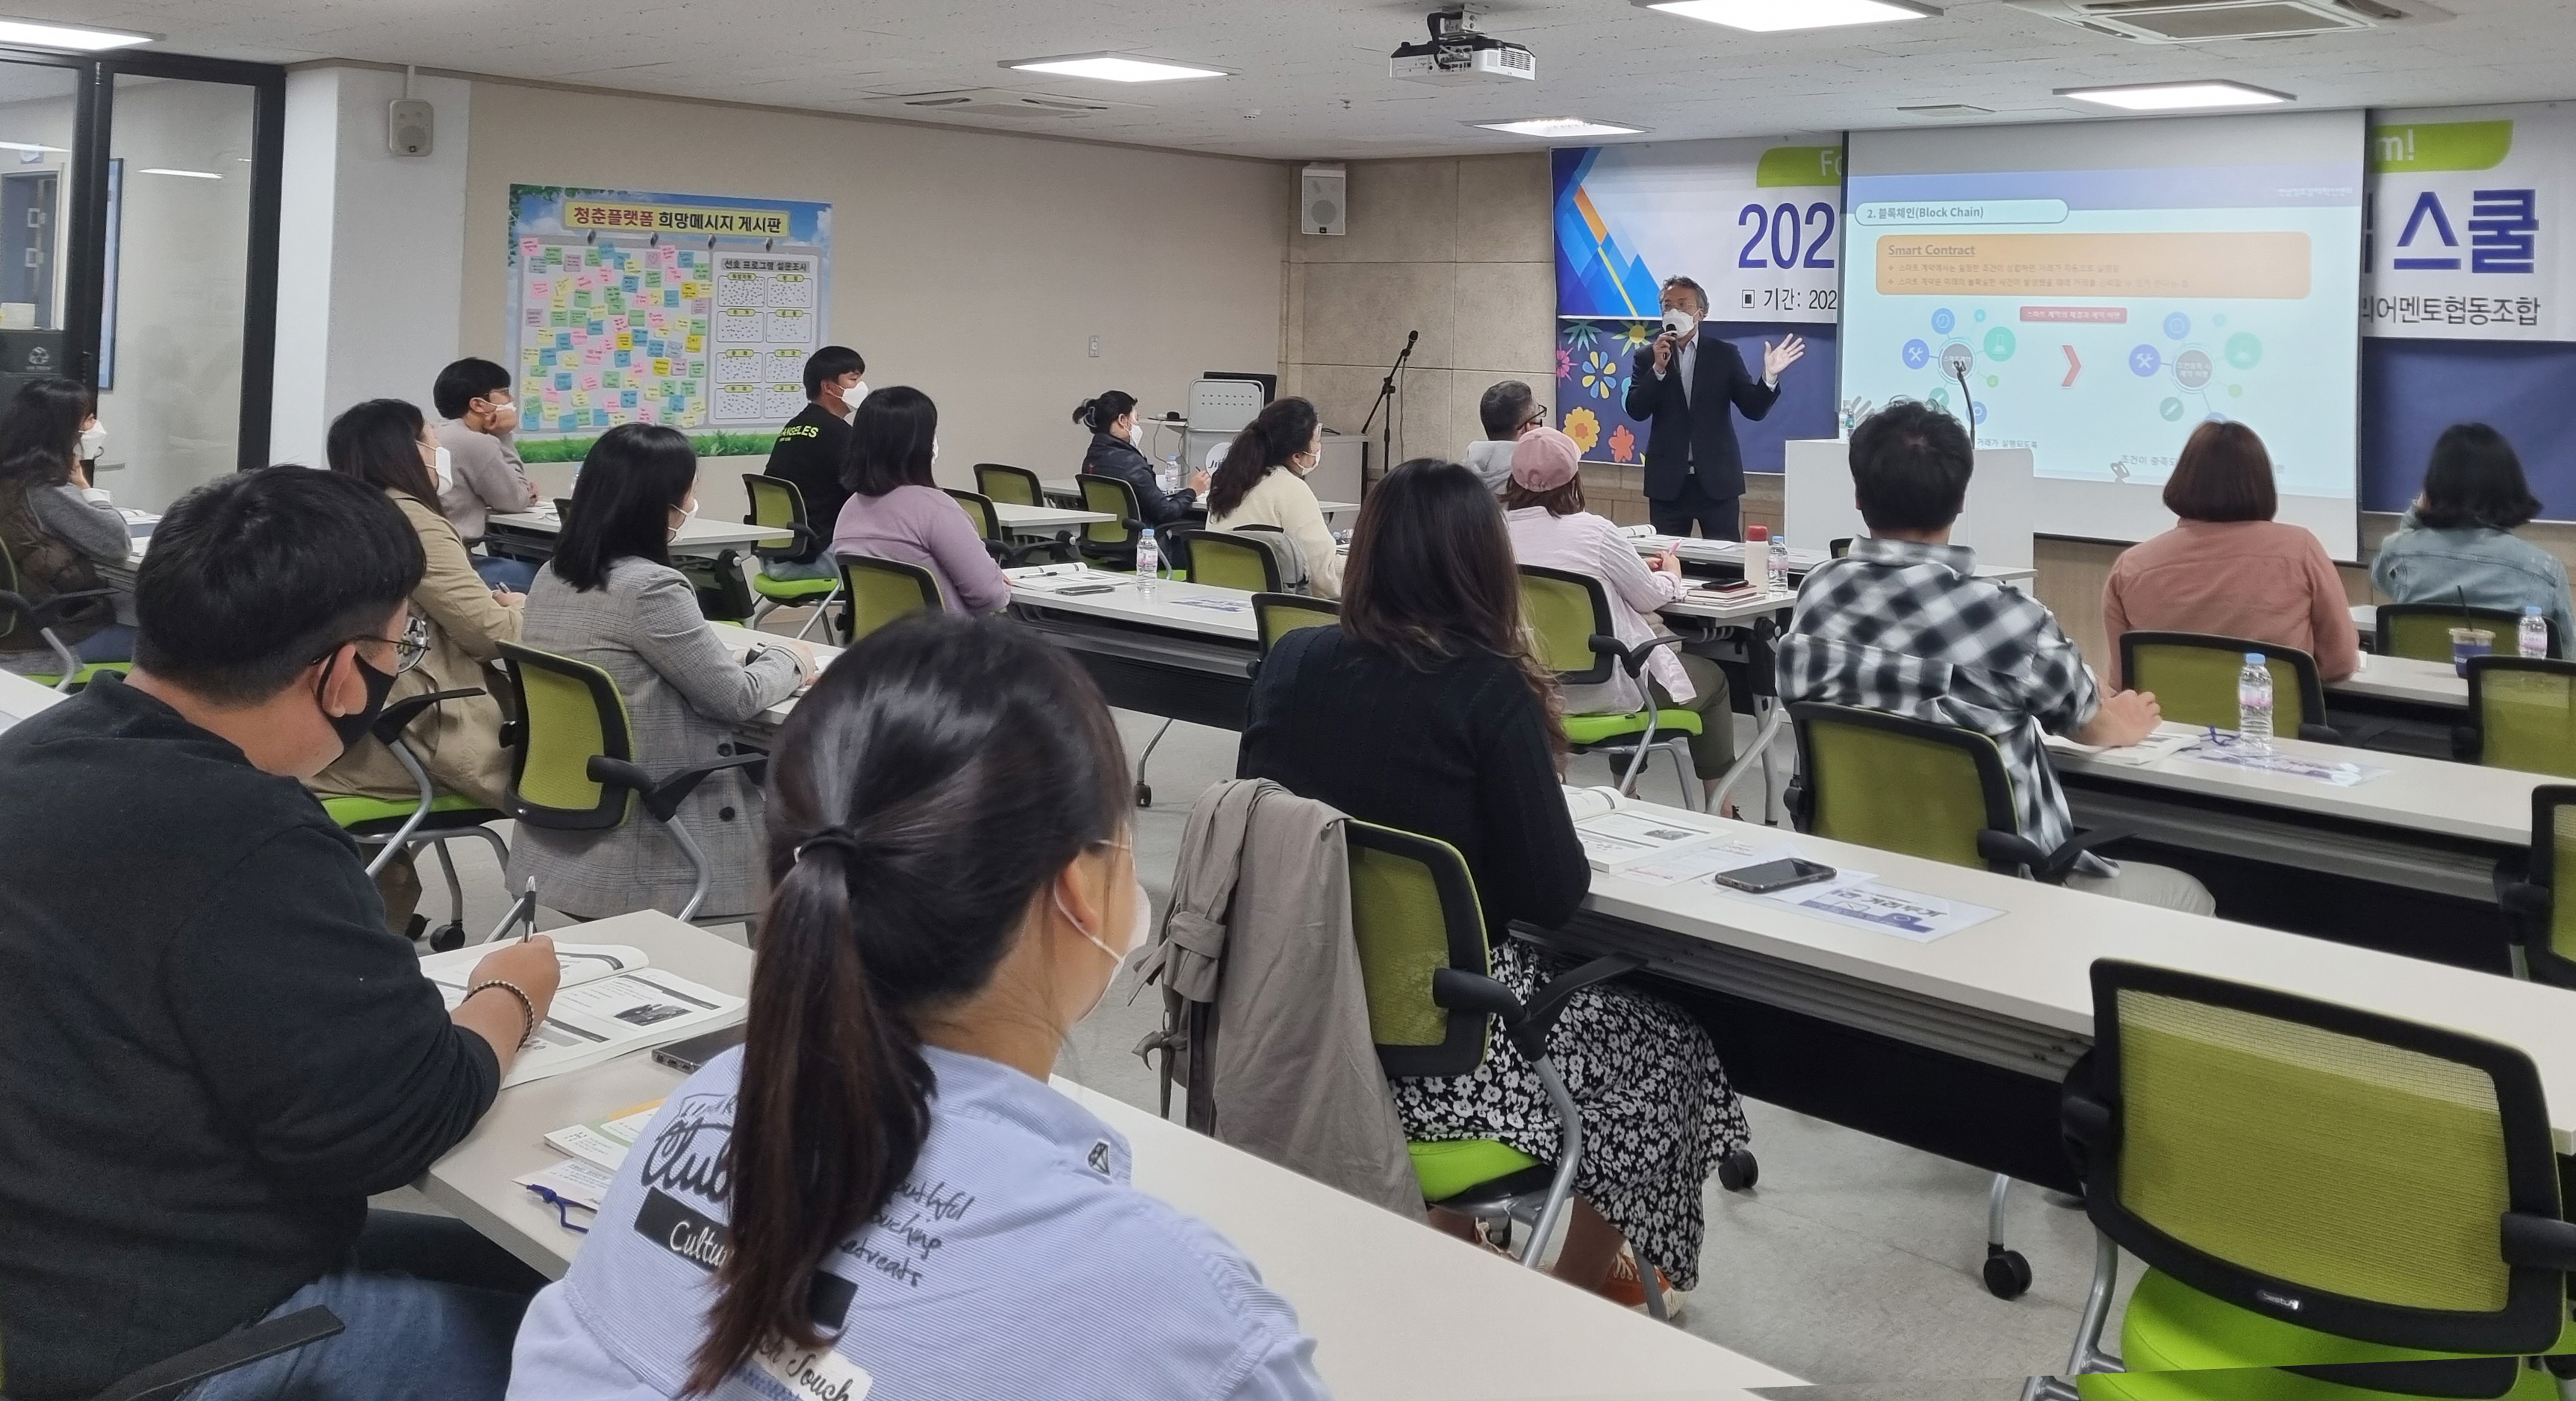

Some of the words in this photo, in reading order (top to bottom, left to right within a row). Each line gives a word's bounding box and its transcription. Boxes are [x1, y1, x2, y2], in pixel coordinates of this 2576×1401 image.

[1867, 209, 1876, 219] 2.
[1950, 206, 1984, 219] Chain)
[574, 207, 654, 227] 청춘플랫폼
[658, 210, 733, 231] 희망메시지
[738, 216, 782, 234] 게시판
[1888, 245, 1923, 255] Smart
[1924, 244, 1976, 256] Contract
[743, 260, 774, 270] 프로그램
[1764, 287, 1801, 311] 기간:
